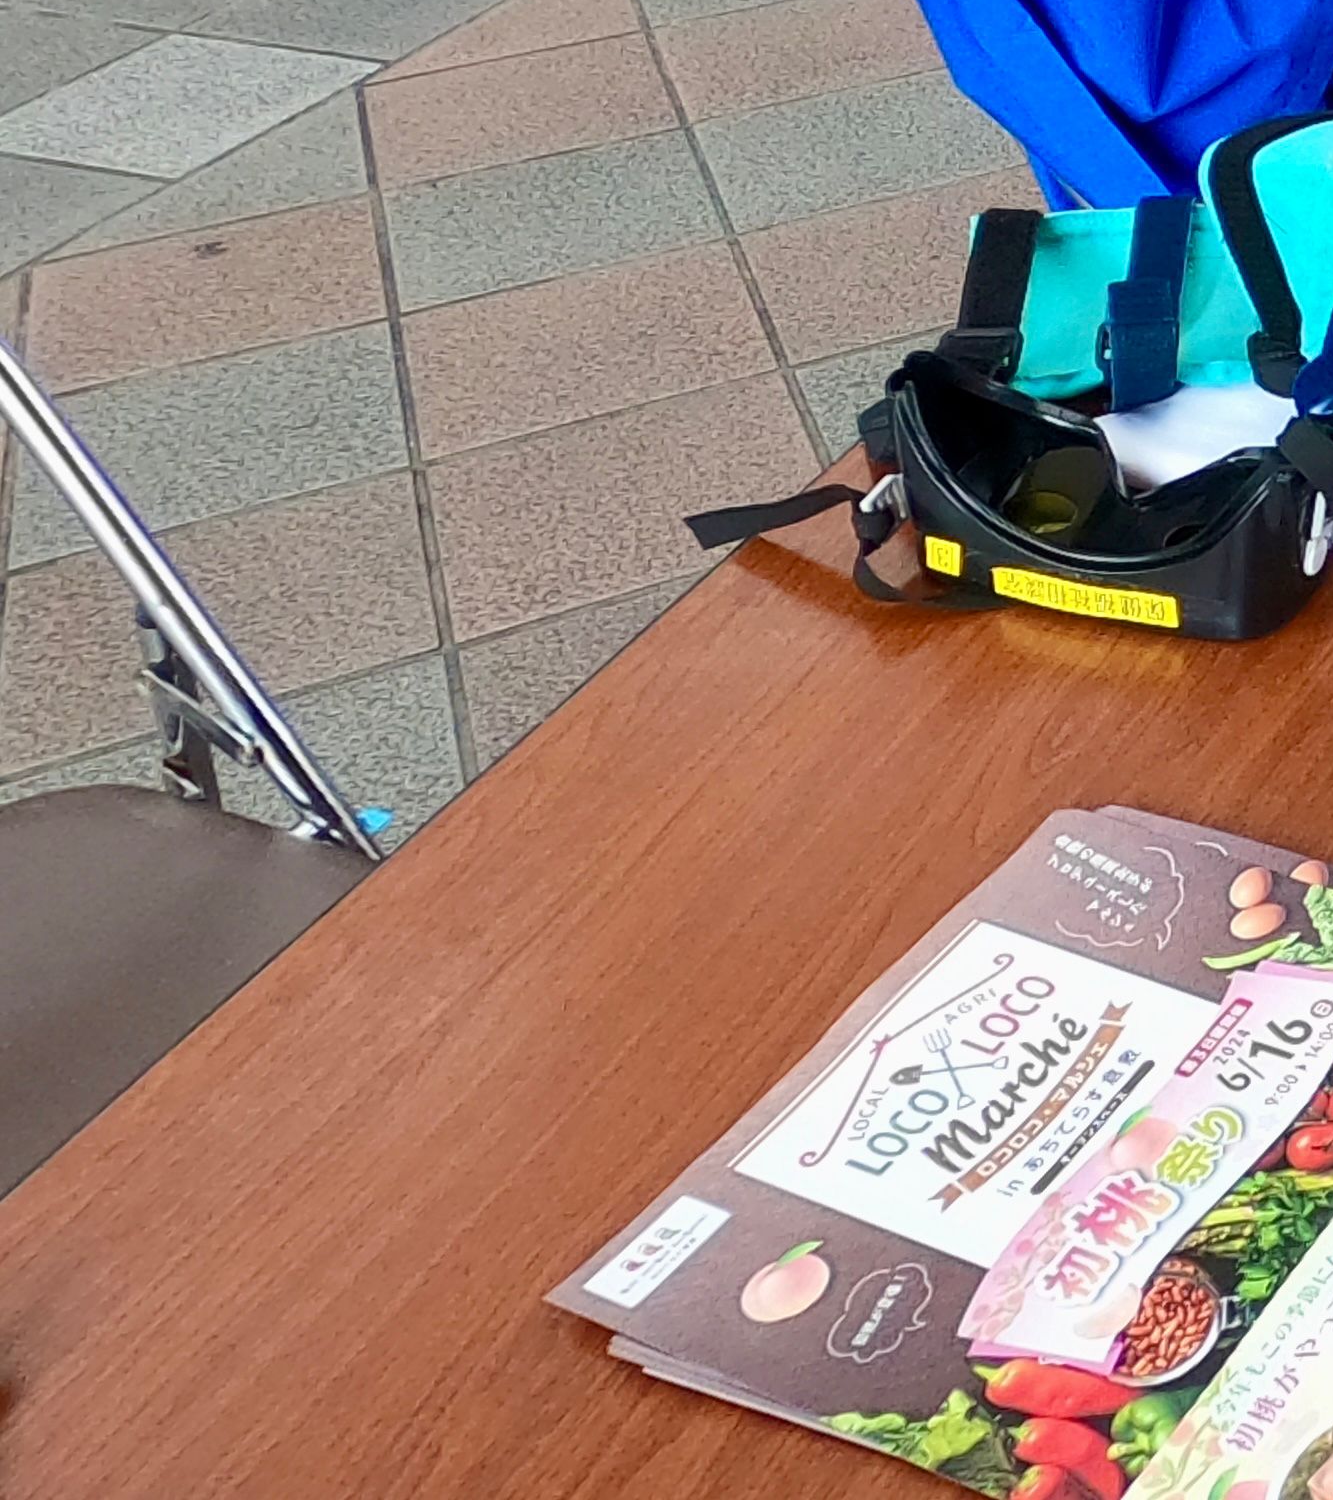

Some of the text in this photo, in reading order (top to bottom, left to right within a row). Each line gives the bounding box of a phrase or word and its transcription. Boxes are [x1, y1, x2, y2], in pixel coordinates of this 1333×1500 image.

[943, 987, 999, 1026] AGRI
[844, 975, 1056, 1176] LOCO LOCO
[1213, 1028, 1251, 1066] 2024
[1216, 1018, 1314, 1092] 6/16
[847, 1086, 890, 1142] LOCAL
[920, 1012, 1088, 1174] Marché
